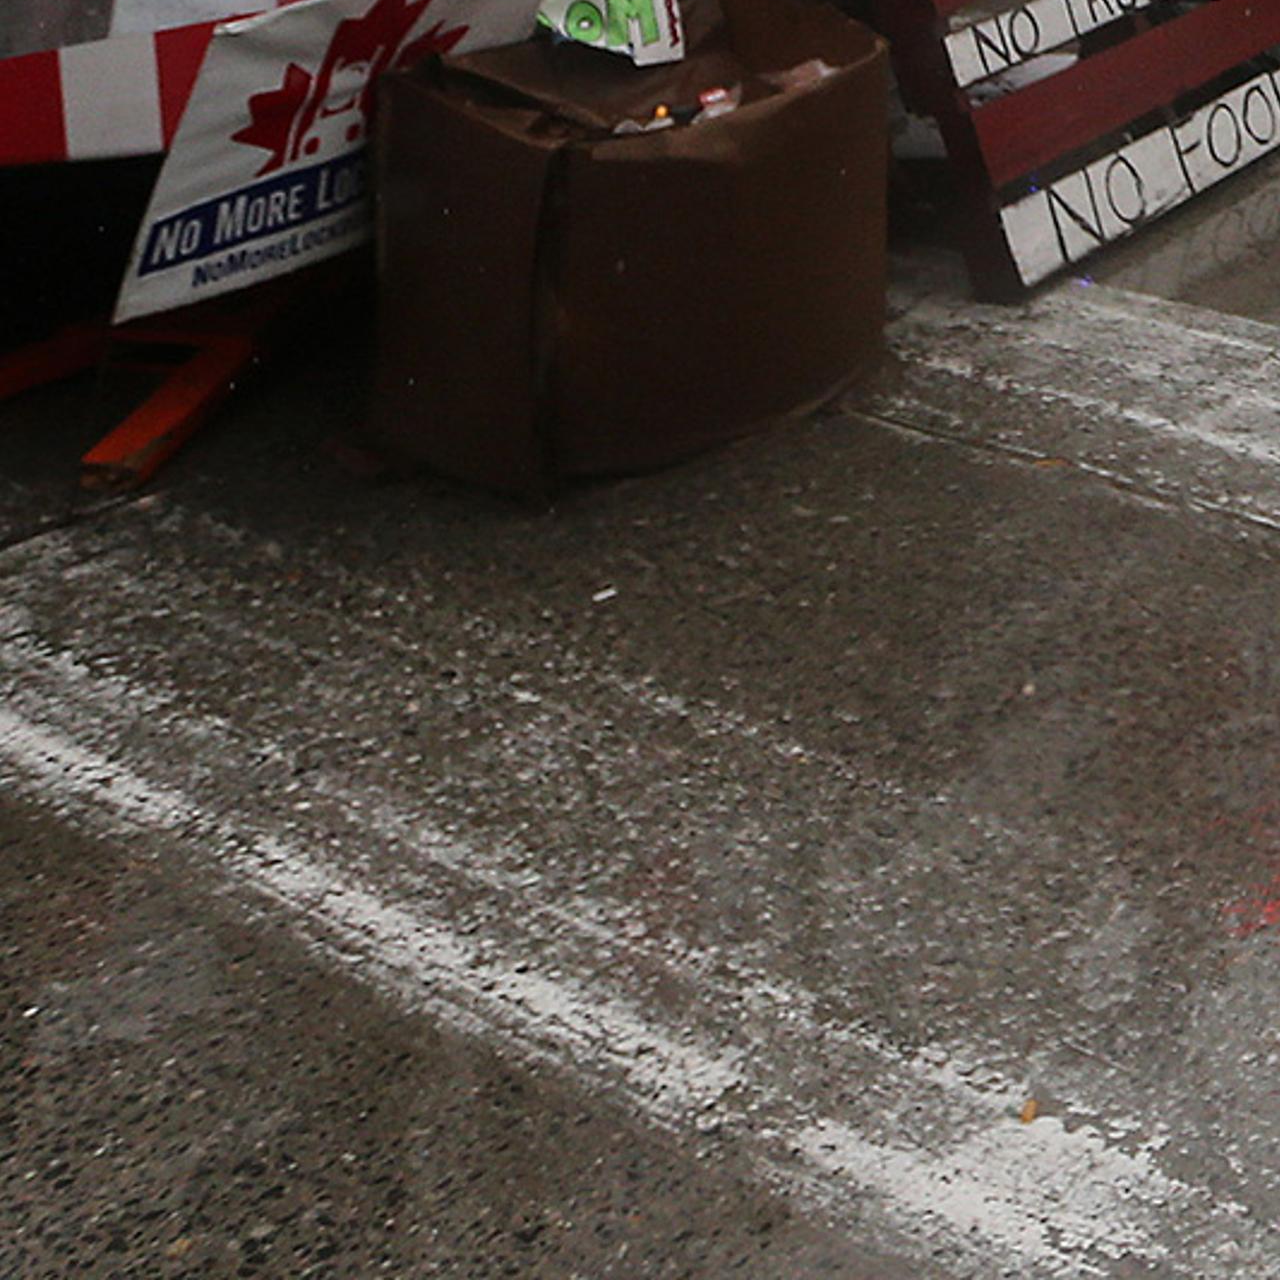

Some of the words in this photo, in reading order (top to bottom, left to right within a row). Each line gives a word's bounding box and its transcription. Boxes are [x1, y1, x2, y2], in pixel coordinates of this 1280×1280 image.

[970, 5, 1040, 77] NO
[151, 218, 201, 266] NO
[1046, 154, 1147, 265] NO
